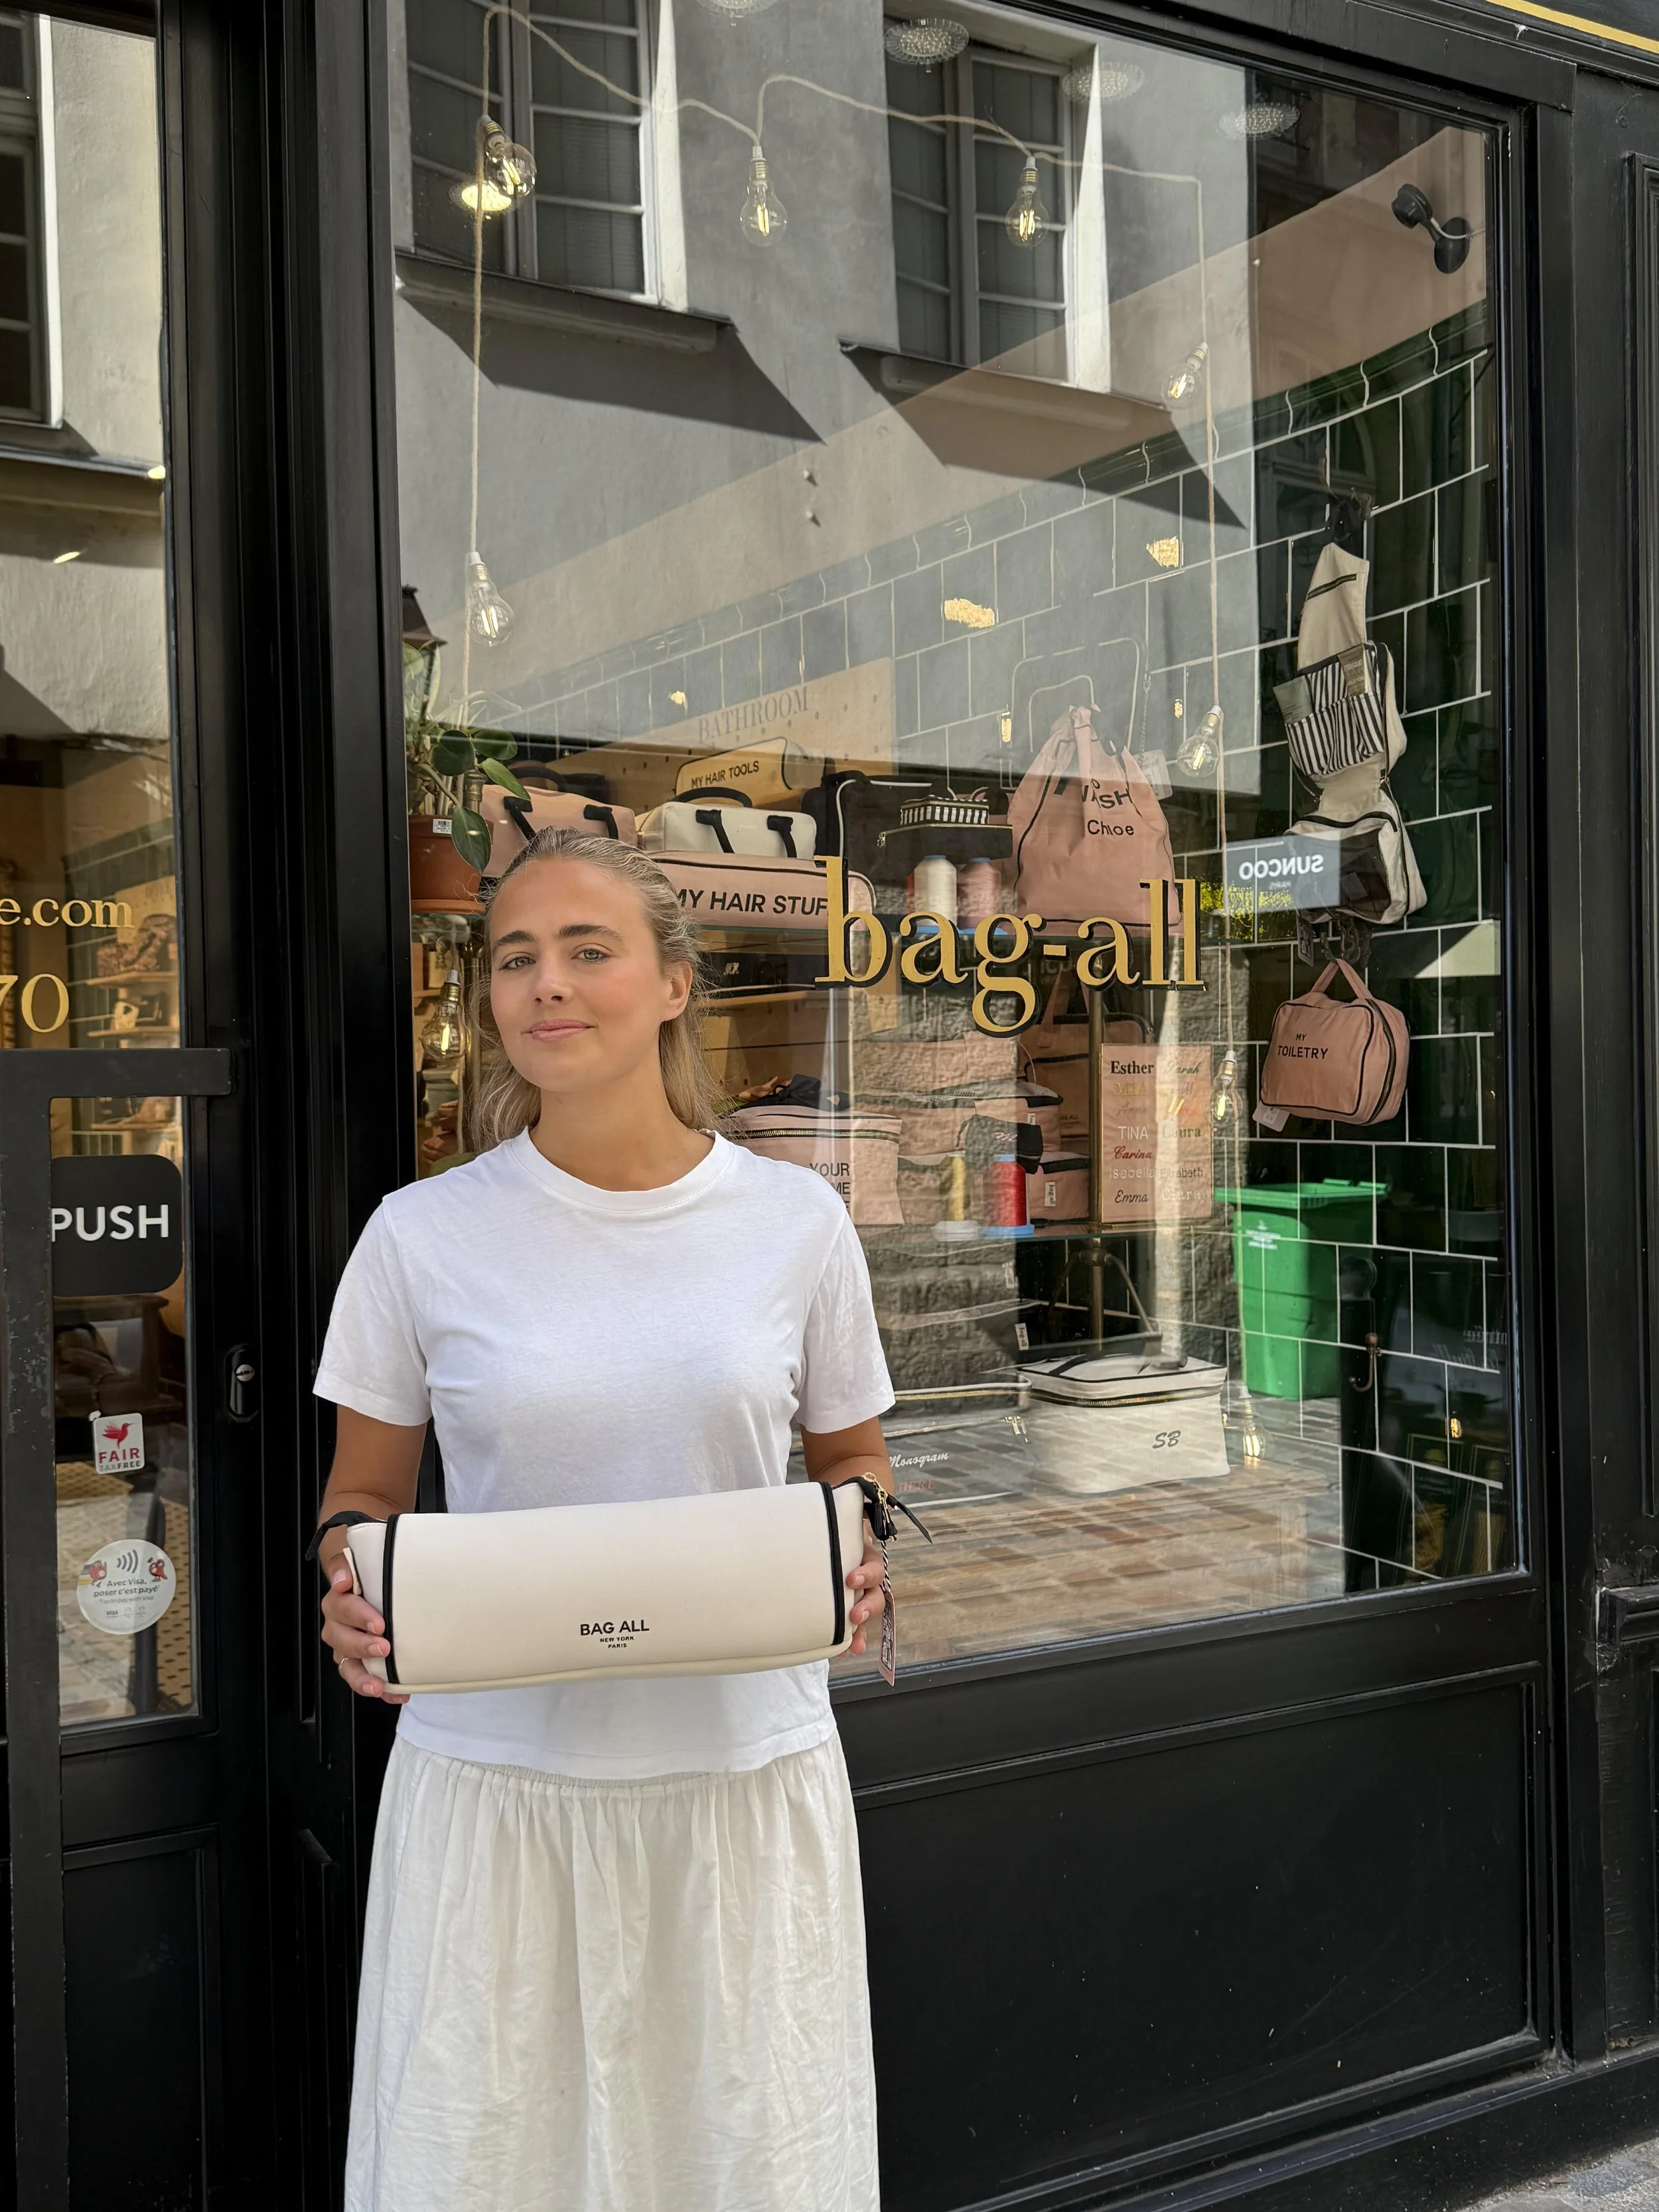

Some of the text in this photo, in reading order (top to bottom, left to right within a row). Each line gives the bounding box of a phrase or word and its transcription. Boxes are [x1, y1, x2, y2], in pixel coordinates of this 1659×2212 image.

[699, 686, 808, 743] BATHROOM
[691, 761, 759, 788] MY HAIR TOOLS
[1088, 820, 1134, 836] Chloe
[709, 891, 766, 913] HAIR
[772, 895, 828, 916] STUF
[814, 855, 1206, 1035] bag-all
[1277, 1045, 1329, 1059] TOILETRY
[1110, 1061, 1155, 1074] Esther
[1118, 1126, 1149, 1140] TINA
[1114, 1145, 1153, 1159] Carina
[810, 1163, 850, 1177] YOUR
[1114, 1189, 1149, 1204] Emma
[51, 1204, 169, 1242] PUSH
[1152, 1430, 1181, 1449] SB
[99, 1447, 140, 1464] FAIR
[889, 1453, 950, 1467] Monogram
[580, 1619, 650, 1636] BAG ALL
